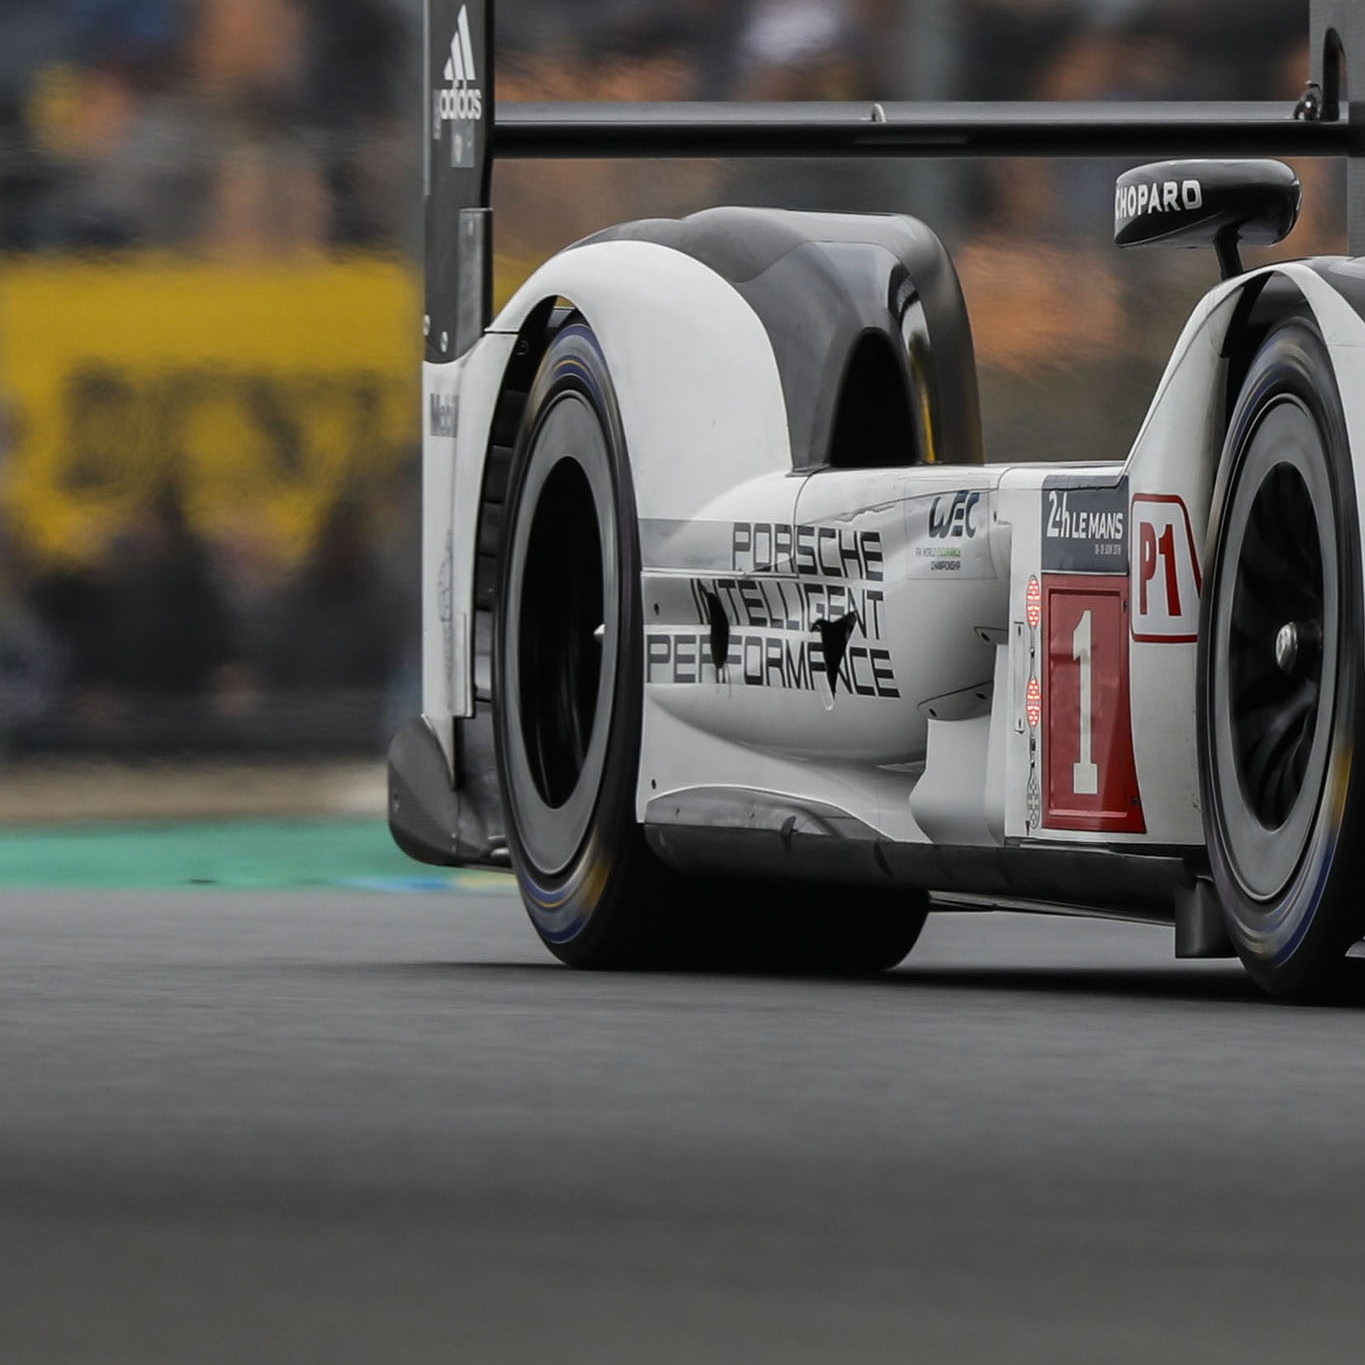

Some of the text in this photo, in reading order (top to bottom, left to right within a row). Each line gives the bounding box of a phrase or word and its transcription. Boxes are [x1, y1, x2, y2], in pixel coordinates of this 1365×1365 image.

[440, 80, 482, 120] adidas
[1115, 180, 1203, 219] CHOPARD
[929, 490, 981, 538] WEC
[1072, 512, 1088, 539] LE
[1088, 512, 1124, 540] MANS
[732, 522, 884, 582] PORSCHE
[1140, 522, 1182, 616] P1
[690, 578, 885, 640] INTELLIGENT
[1072, 610, 1098, 795] 1
